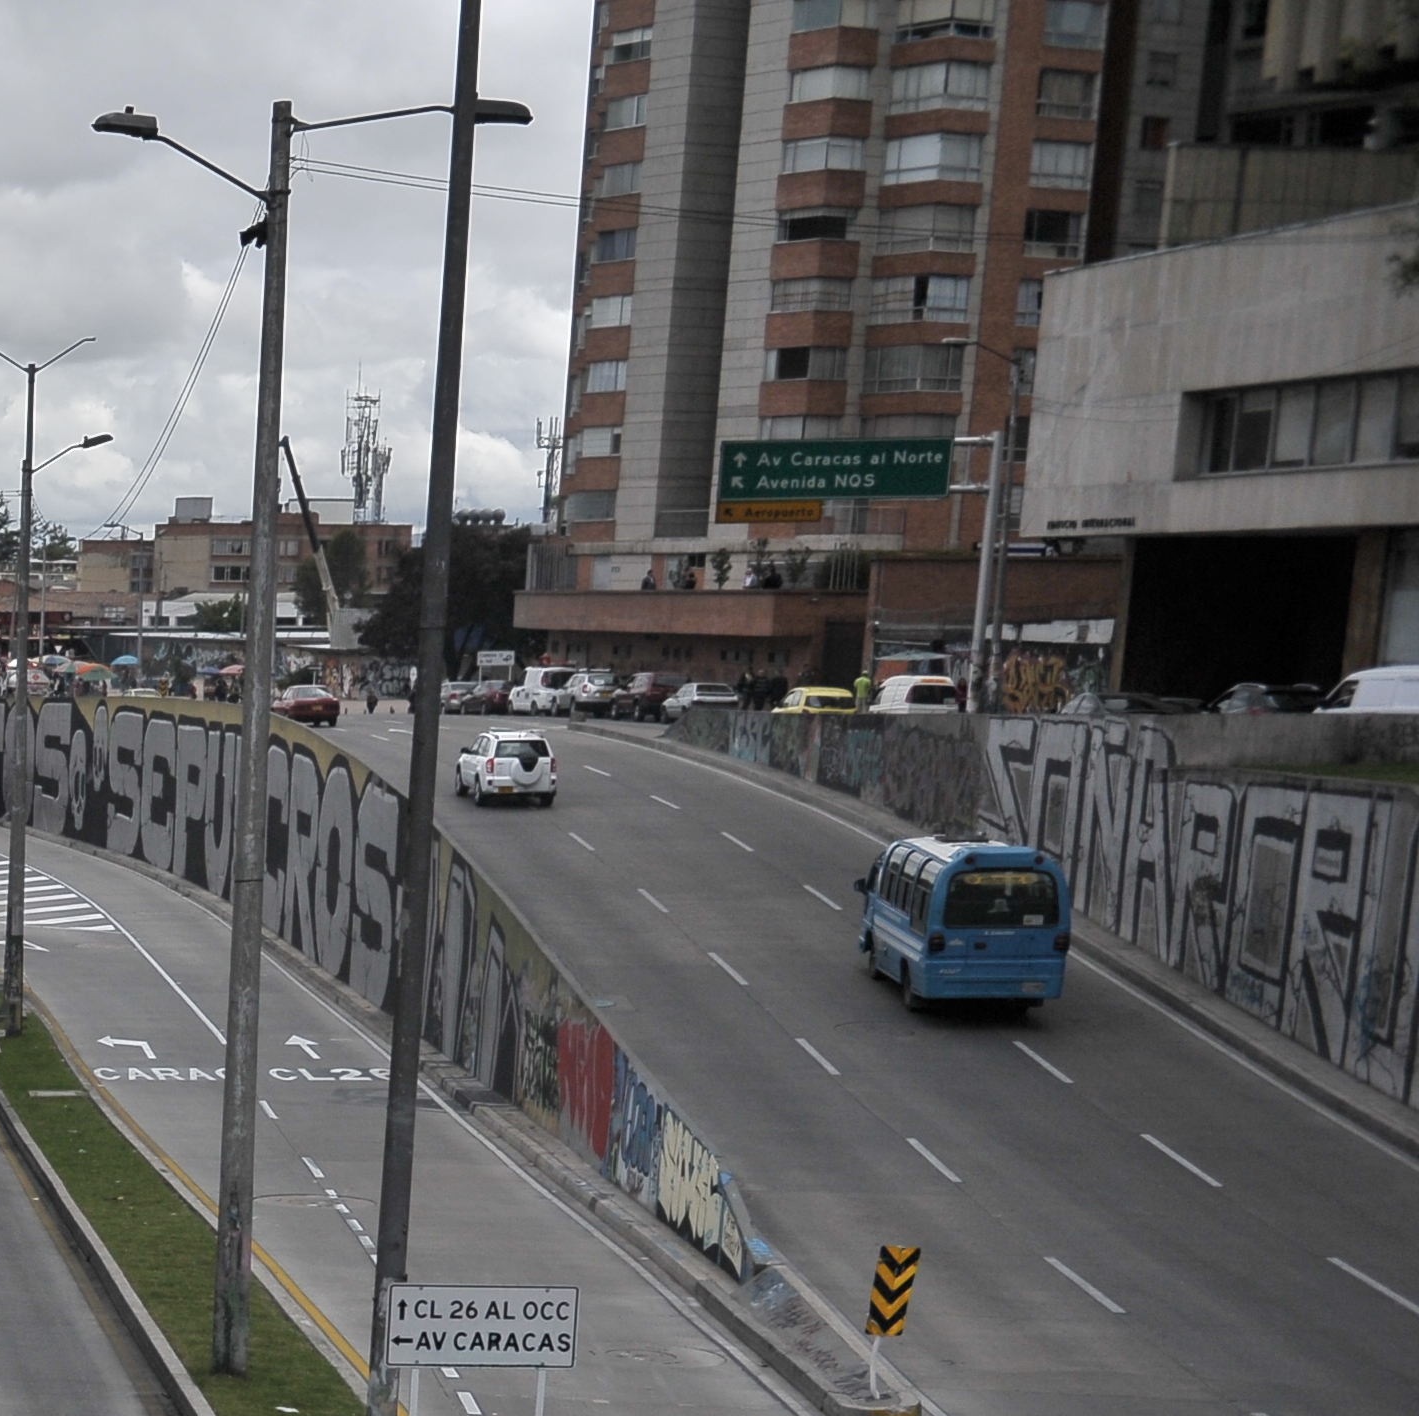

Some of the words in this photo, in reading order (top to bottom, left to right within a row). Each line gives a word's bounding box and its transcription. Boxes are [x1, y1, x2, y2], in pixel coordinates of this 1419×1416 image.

[756, 452, 782, 467] Av
[790, 451, 862, 467] Caracas
[869, 451, 886, 466] al
[893, 450, 944, 465] Norte
[756, 475, 826, 490] Avenida
[744, 506, 814, 519] Aeropuerto
[413, 1298, 443, 1320] CL
[449, 1299, 479, 1320] 26
[484, 1300, 516, 1320] AL
[521, 1300, 571, 1321] OCC
[415, 1330, 447, 1351] AV
[452, 1330, 572, 1353] CARACAS
